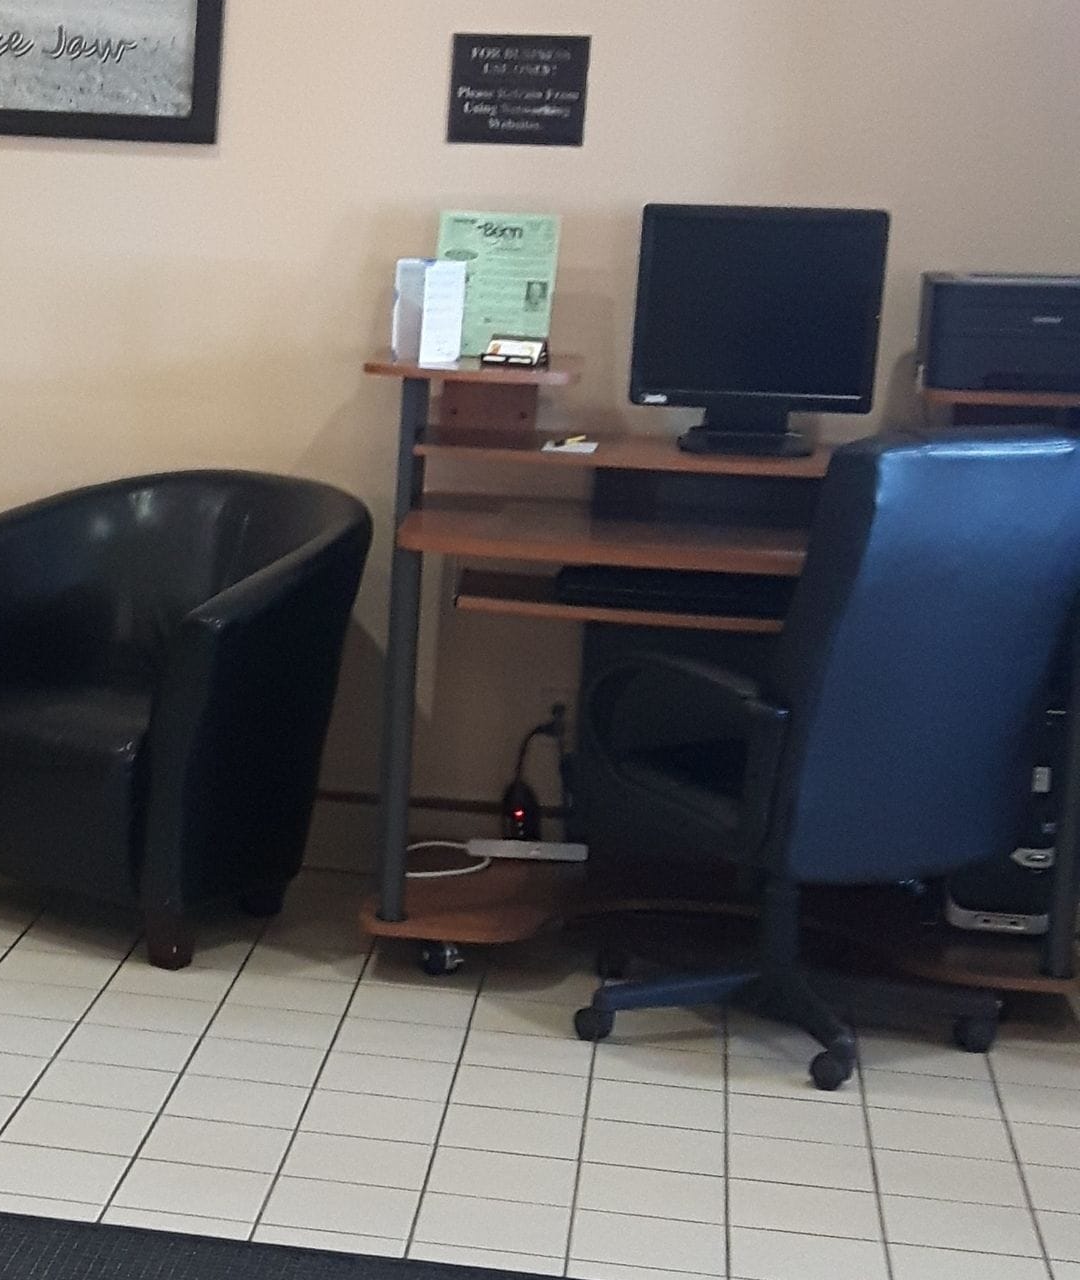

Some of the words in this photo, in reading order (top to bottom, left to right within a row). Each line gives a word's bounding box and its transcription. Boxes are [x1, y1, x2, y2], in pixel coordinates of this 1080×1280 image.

[42, 24, 139, 64] Jaw
[471, 46, 502, 60] FOR
[456, 85, 494, 99] Please
